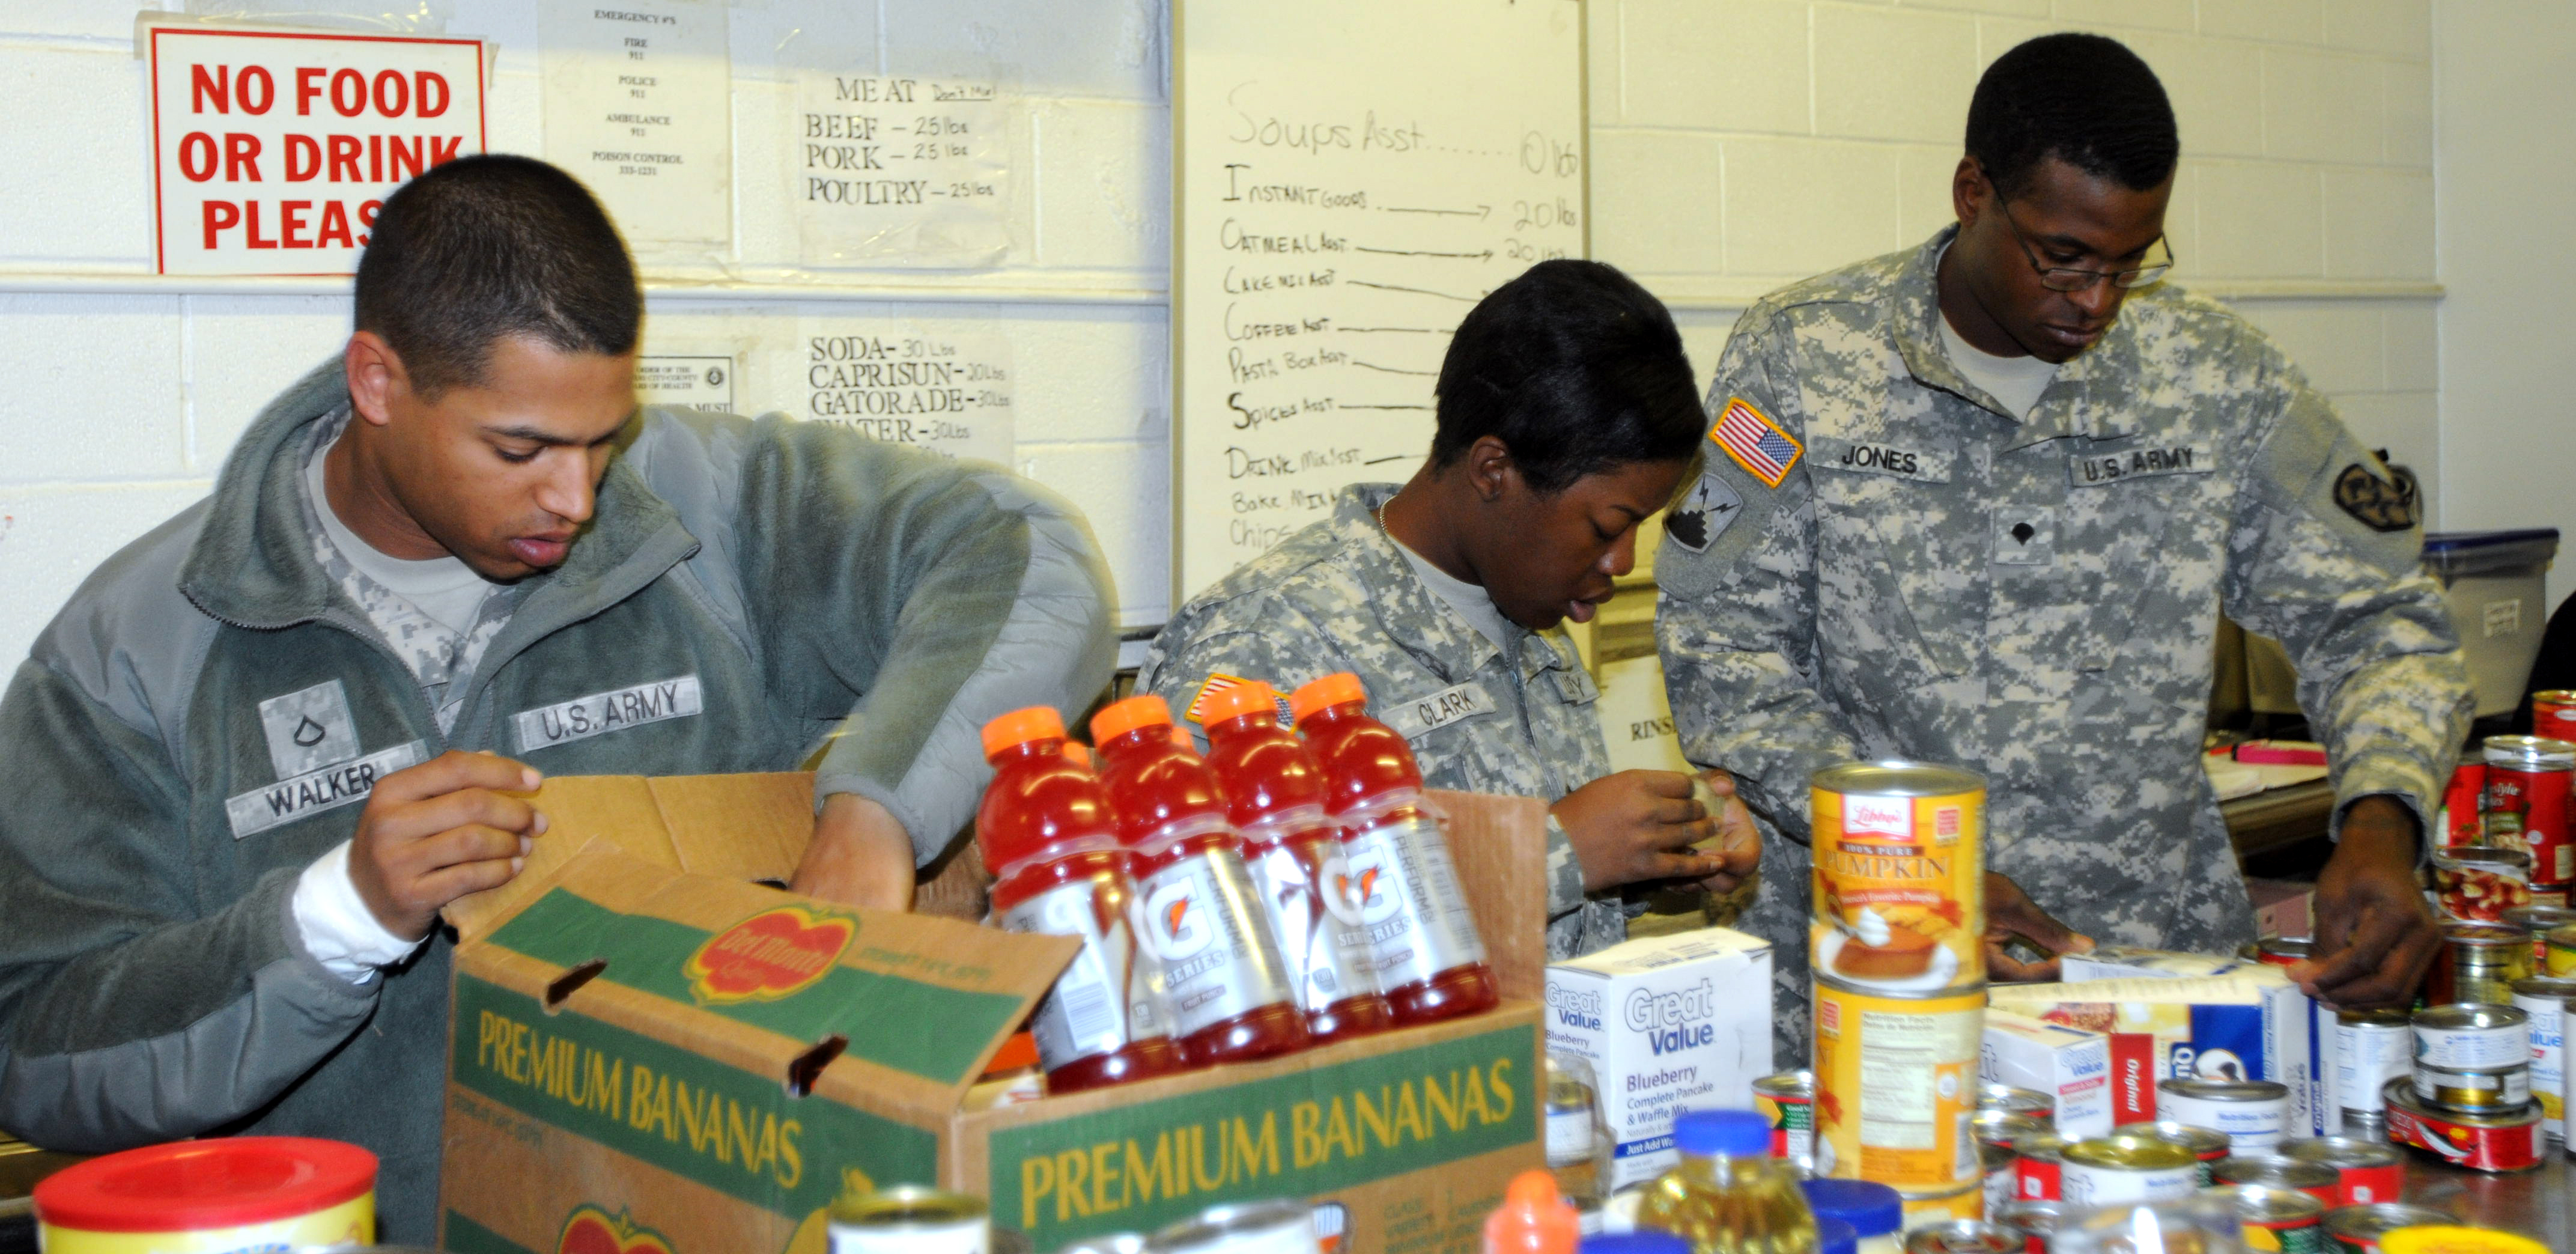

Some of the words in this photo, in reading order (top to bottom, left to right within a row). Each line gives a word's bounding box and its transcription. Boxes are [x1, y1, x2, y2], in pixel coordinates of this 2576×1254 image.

[594, 10, 659, 23] EMERGENCY
[624, 38, 648, 47] FIRE
[629, 51, 644, 59] 911
[191, 64, 275, 115] NO
[296, 67, 450, 118] FOOD
[619, 76, 657, 86] POLICE
[630, 90, 645, 99] 911
[835, 78, 917, 102] MEAT
[606, 114, 670, 125] AMBULANCE
[805, 114, 878, 140] BEEF
[1228, 81, 1350, 154] Soups
[631, 128, 646, 136] 911
[178, 132, 263, 182] OR
[284, 134, 463, 182] DRINK
[592, 151, 630, 161] POISON
[633, 154, 683, 164] CONTROL
[806, 144, 883, 169] PORK
[807, 177, 927, 205] POULTRY
[202, 199, 386, 249] PLEAS
[1513, 200, 1552, 232] 20
[902, 339, 923, 358] 30
[1842, 446, 1918, 475] JONES
[2083, 455, 2126, 482] U.S.
[2131, 447, 2195, 472] ARMY
[542, 704, 598, 740] U.S.
[604, 684, 679, 728] ARMY
[1418, 689, 1477, 726] CLARK
[1631, 716, 1677, 741] RINS
[265, 762, 375, 817] WALKER
[1850, 805, 1902, 827] Libby's
[1845, 844, 1873, 854] 100%
[1878, 845, 1913, 856] PURE
[1395, 835, 1432, 913] PERFORM
[1825, 850, 1949, 880] PUMPKIN
[1146, 874, 1215, 961] G
[1165, 949, 1225, 988] SERIES
[1545, 981, 1602, 1015] Great
[1624, 978, 1713, 1032] Great
[1558, 1008, 1602, 1032] Value
[1545, 1029, 1590, 1050] Blueberry
[1648, 1023, 1714, 1056] Value
[1626, 1064, 1697, 1092] Blueberry
[2124, 1058, 2142, 1113] Original
[479, 1011, 622, 1122] PREMIUM
[630, 1065, 803, 1189] BANANAS
[1627, 1091, 1675, 1110] Complete
[1676, 1081, 1714, 1101] Pancake
[1627, 1113, 1636, 1125] &
[1637, 1107, 1669, 1125] Waffle
[1671, 1105, 1689, 1118] Mix
[1022, 1110, 1281, 1229] PREMIUM
[1292, 1058, 1514, 1170] BANANAS
[1627, 1143, 1644, 1155] Just
[1644, 1138, 1660, 1151] Add
[1660, 1137, 1674, 1148] Wa
